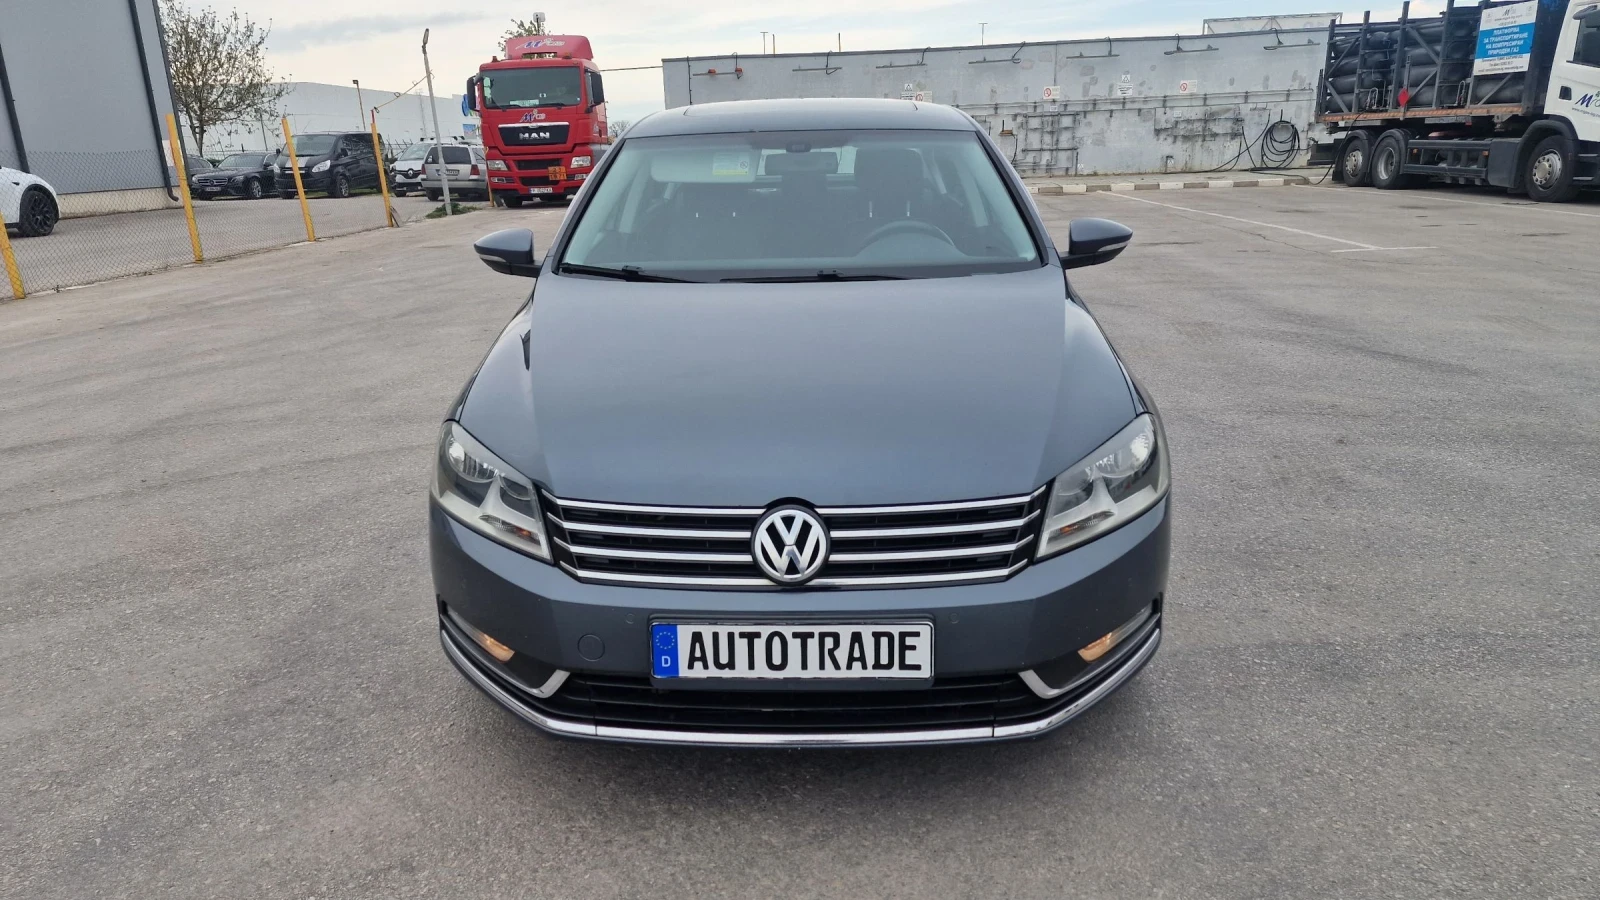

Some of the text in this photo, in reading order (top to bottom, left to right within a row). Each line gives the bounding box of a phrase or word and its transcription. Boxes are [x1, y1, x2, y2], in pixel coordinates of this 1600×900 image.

[1489, 32, 1528, 42] ТРАНСПОРТИРАНЕ
[519, 132, 550, 140] MAN
[756, 511, 825, 580] VW
[661, 630, 922, 672] D AUTOTRADE
